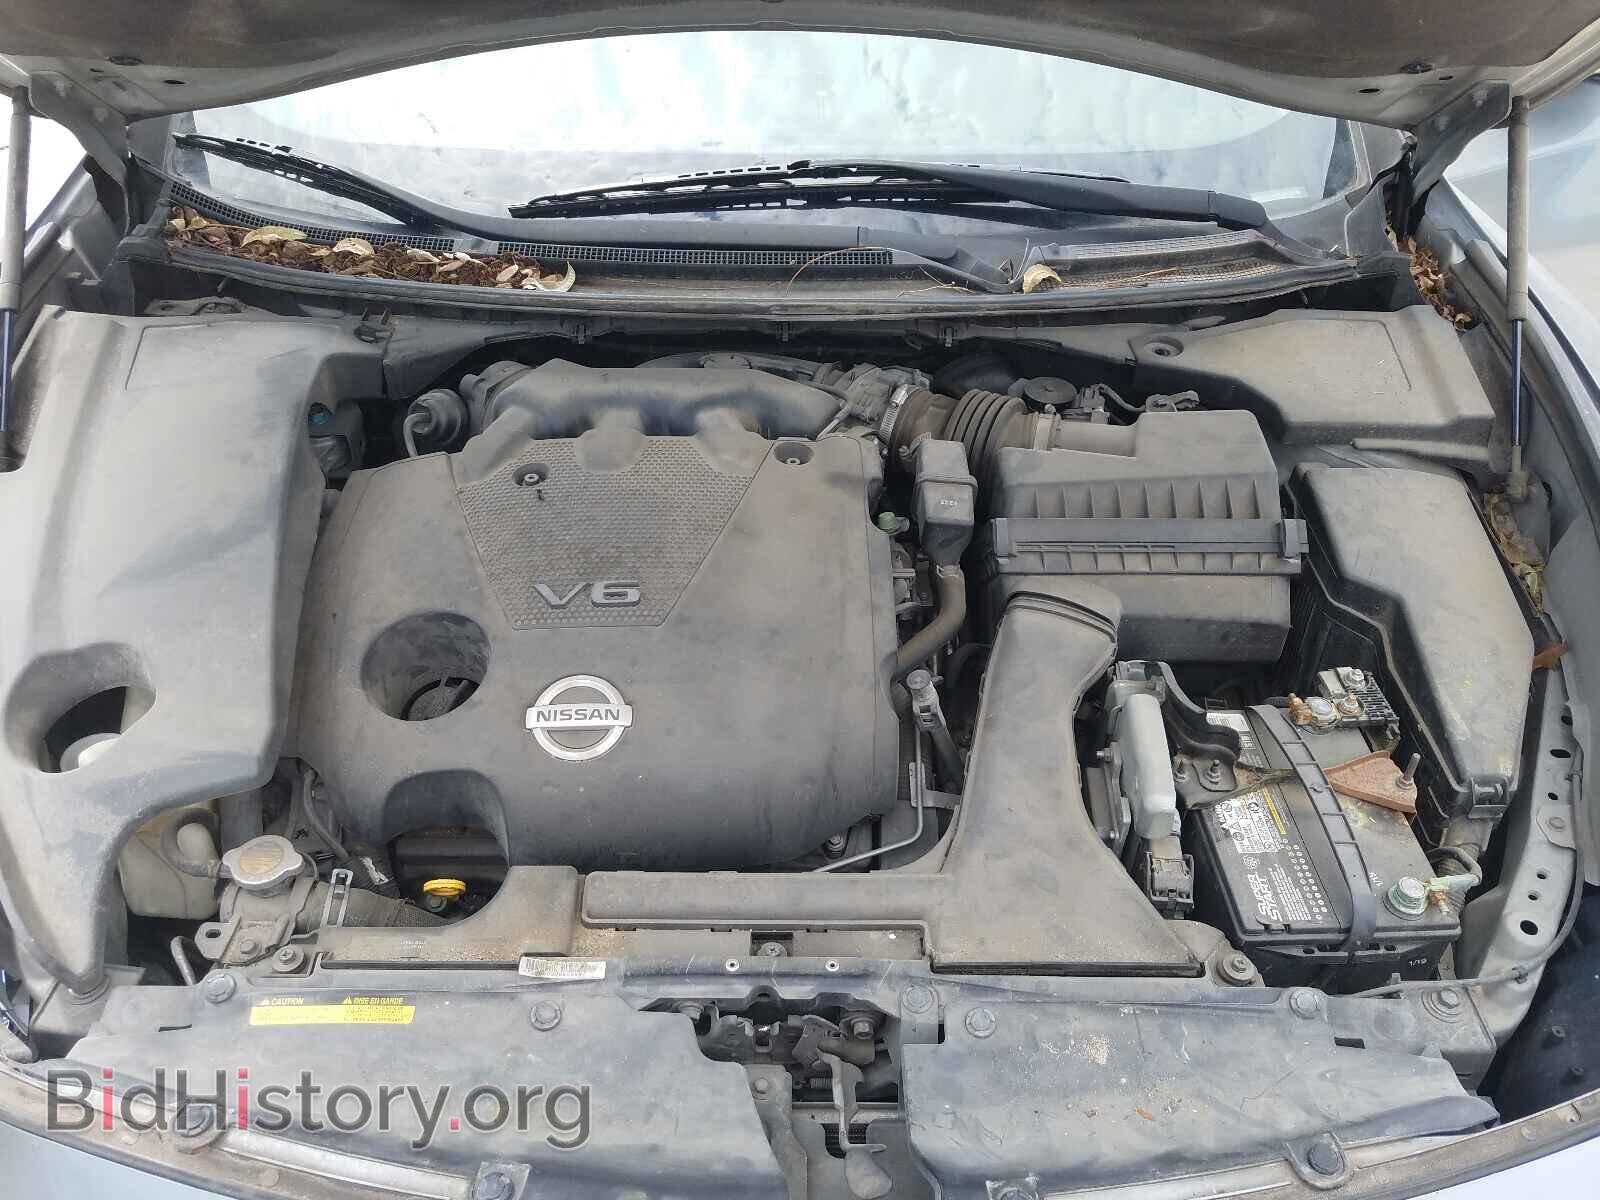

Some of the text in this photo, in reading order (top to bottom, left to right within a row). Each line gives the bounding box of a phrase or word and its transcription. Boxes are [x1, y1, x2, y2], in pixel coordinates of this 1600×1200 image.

[535, 580, 641, 609] V6
[536, 708, 620, 722] NISSAN
[1247, 872, 1269, 915] SUPER
[1258, 878, 1283, 921] START
